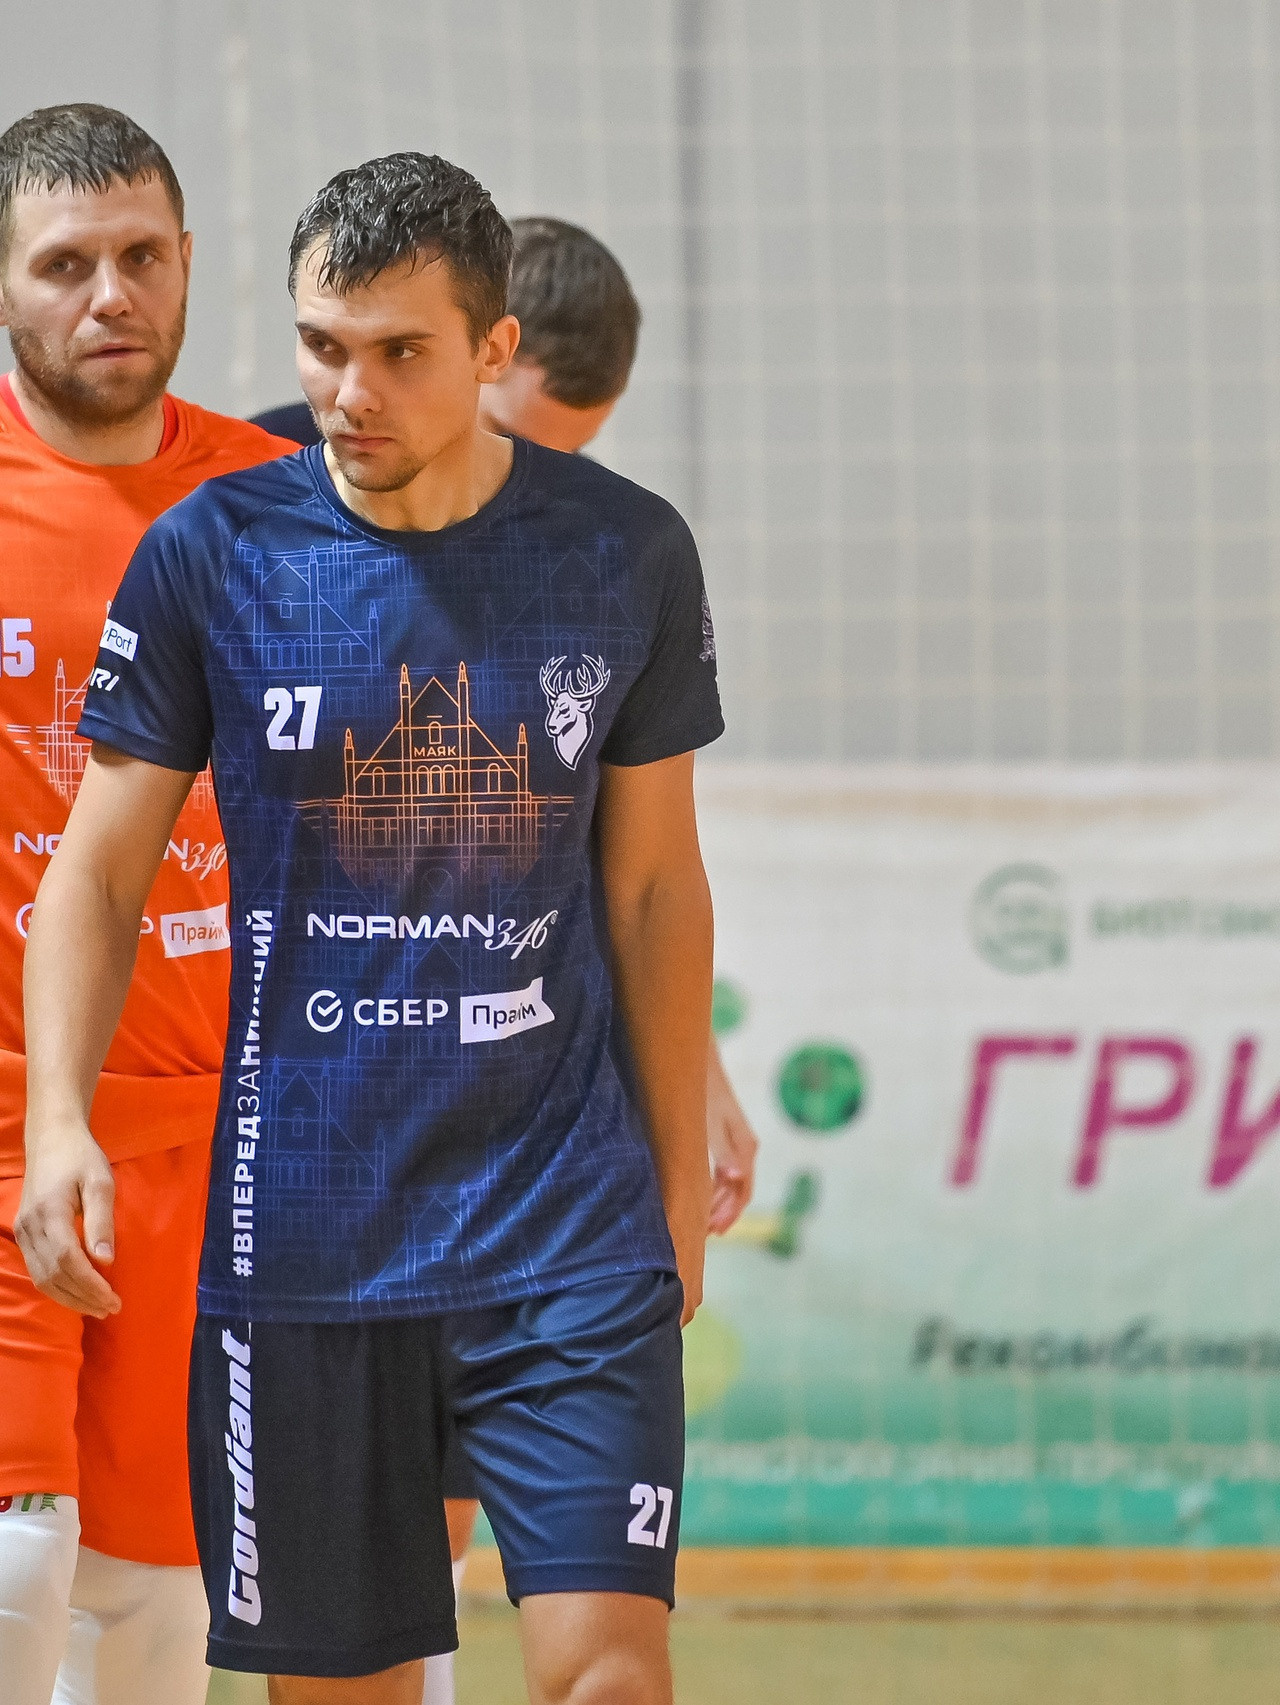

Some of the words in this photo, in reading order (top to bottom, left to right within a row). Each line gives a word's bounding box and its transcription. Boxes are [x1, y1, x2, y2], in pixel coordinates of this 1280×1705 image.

[263, 685, 322, 750] 27
[413, 745, 457, 757] МАЯК
[353, 998, 449, 1027] СБЕР
[221, 1326, 262, 1627] Cordiant
[626, 1482, 674, 1550] 27
